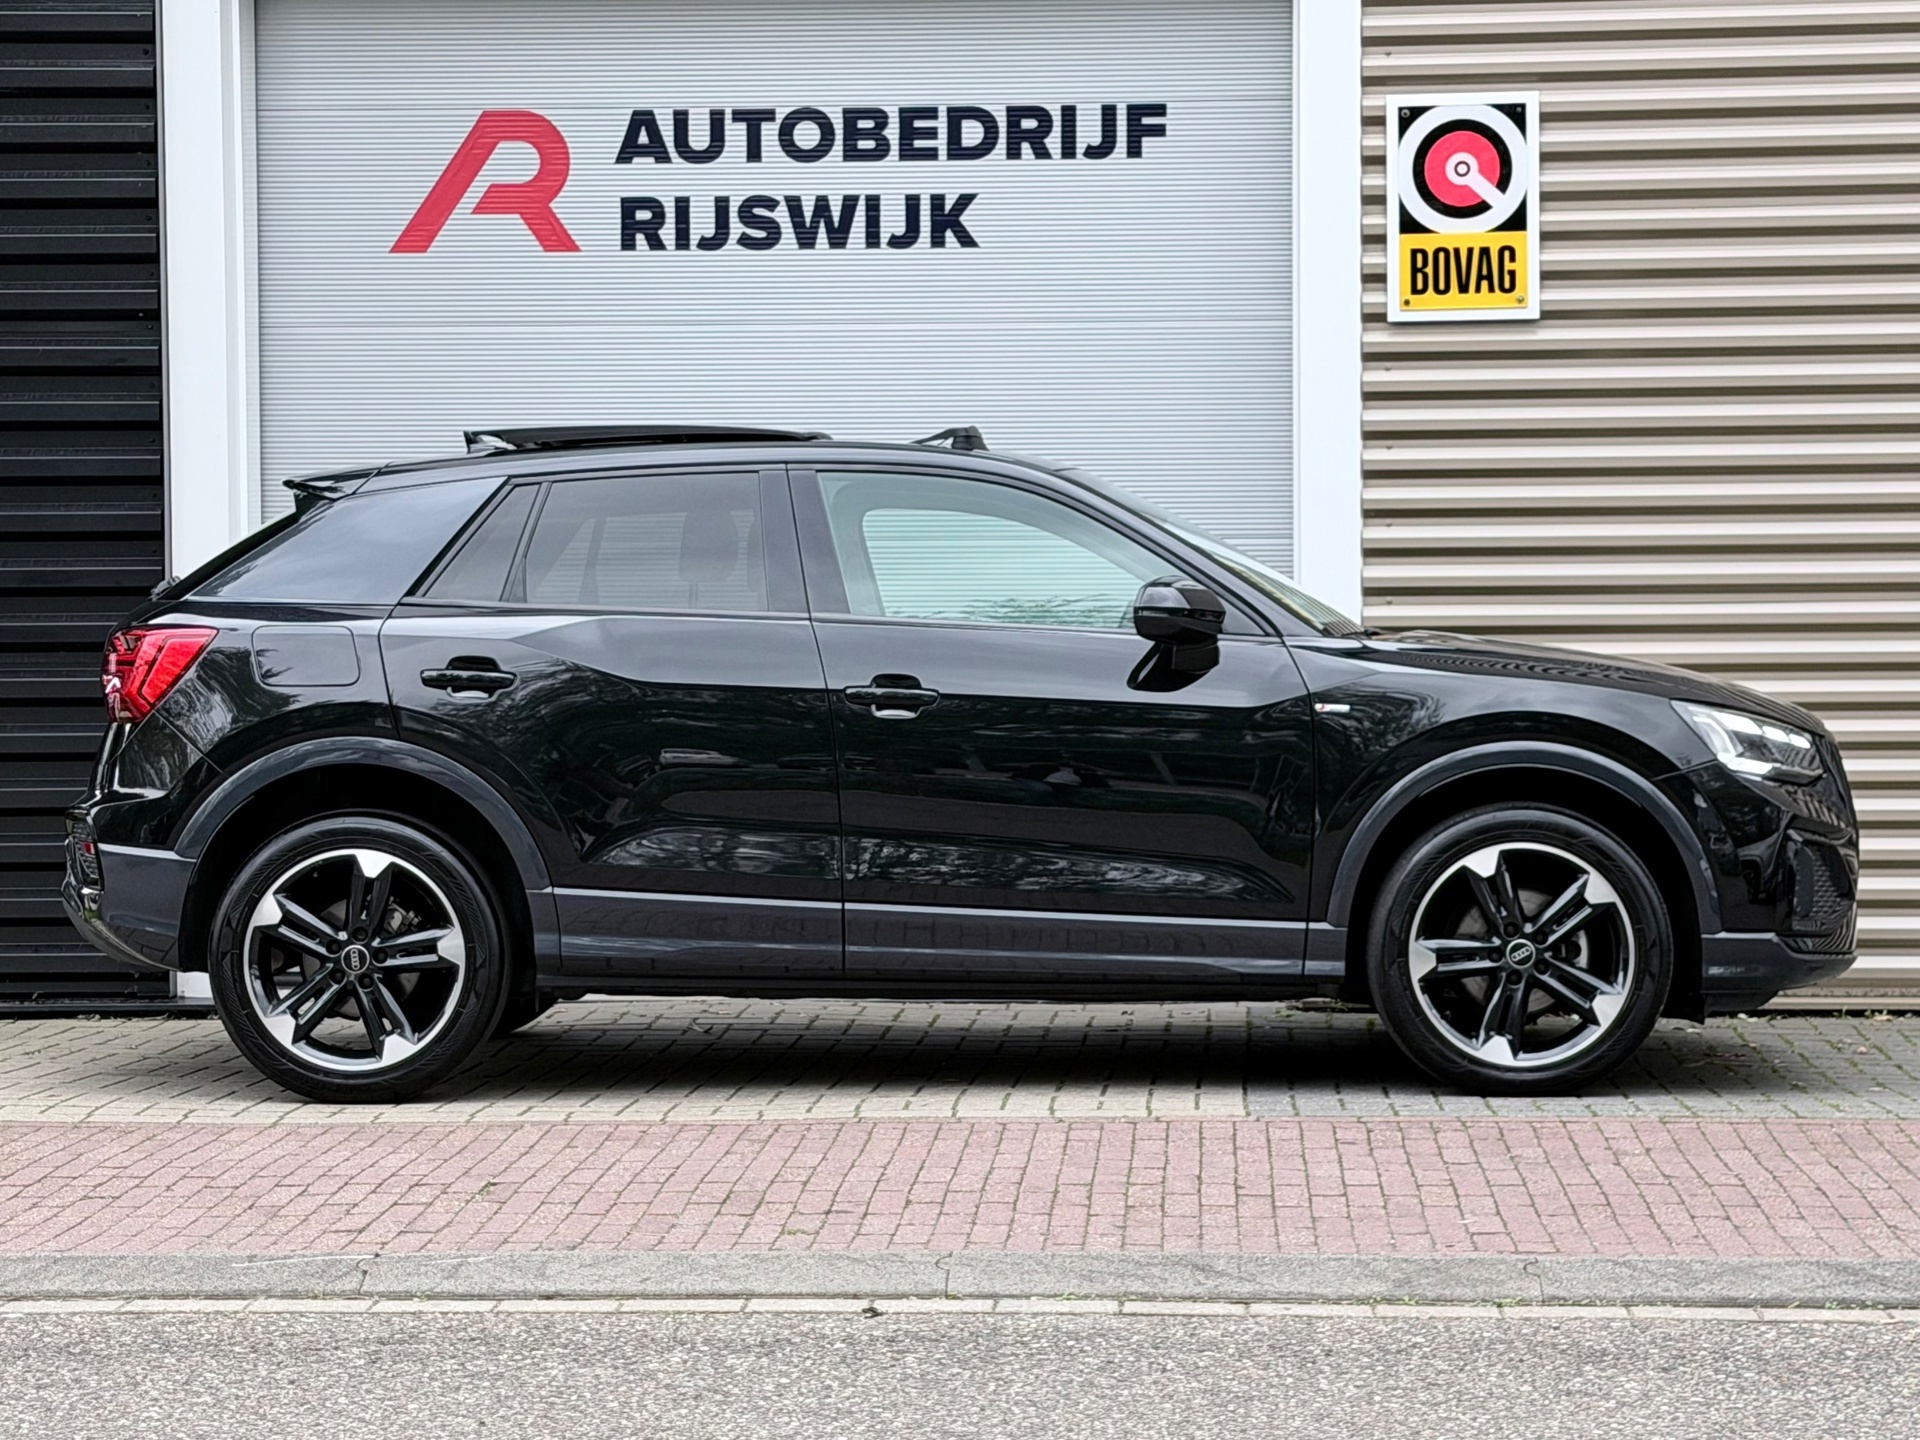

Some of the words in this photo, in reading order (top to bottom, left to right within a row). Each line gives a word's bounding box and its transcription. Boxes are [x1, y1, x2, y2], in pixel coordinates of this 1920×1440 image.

[615, 103, 1167, 164] AUTOBEDRIJF
[620, 194, 979, 250] RIJSWIJK
[1410, 244, 1517, 296] BOVAG
